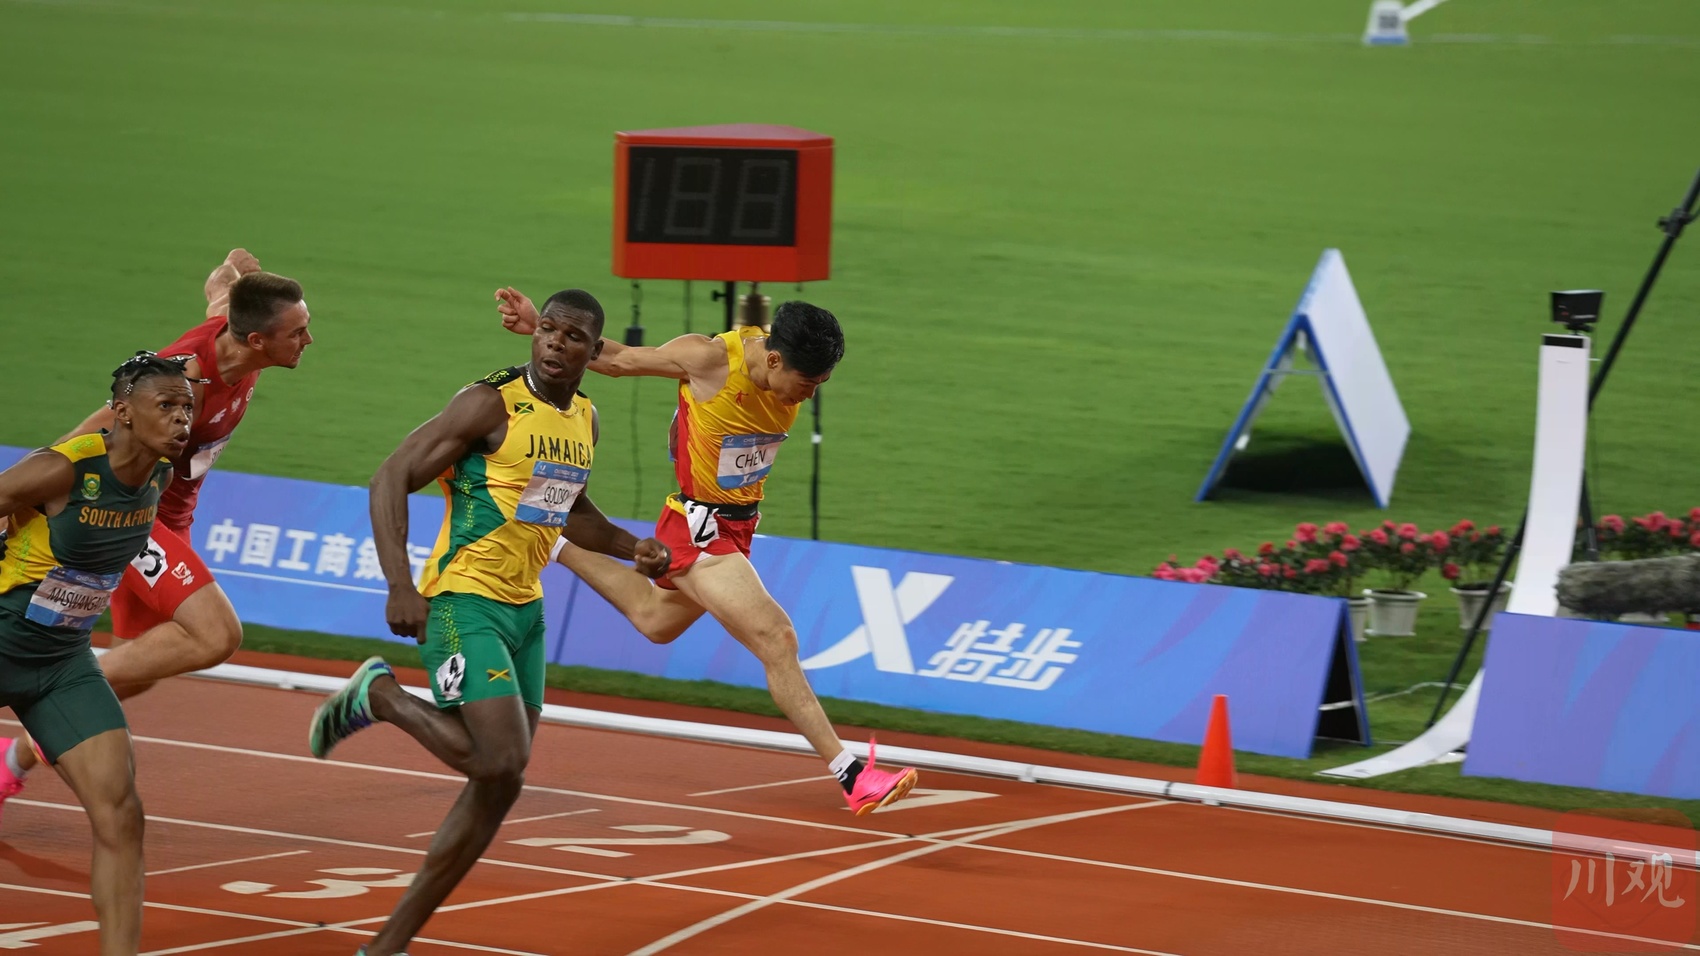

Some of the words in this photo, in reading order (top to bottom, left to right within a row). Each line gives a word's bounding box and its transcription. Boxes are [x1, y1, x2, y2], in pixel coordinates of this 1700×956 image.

[525, 434, 592, 469] JAMAICA
[735, 449, 767, 469] CHEN
[79, 506, 123, 528] SOUTH
[123, 505, 157, 527] AFRIC
[688, 503, 716, 543] 2
[918, 619, 1083, 691] 特步
[504, 824, 733, 858] 2
[219, 867, 418, 899] 3
